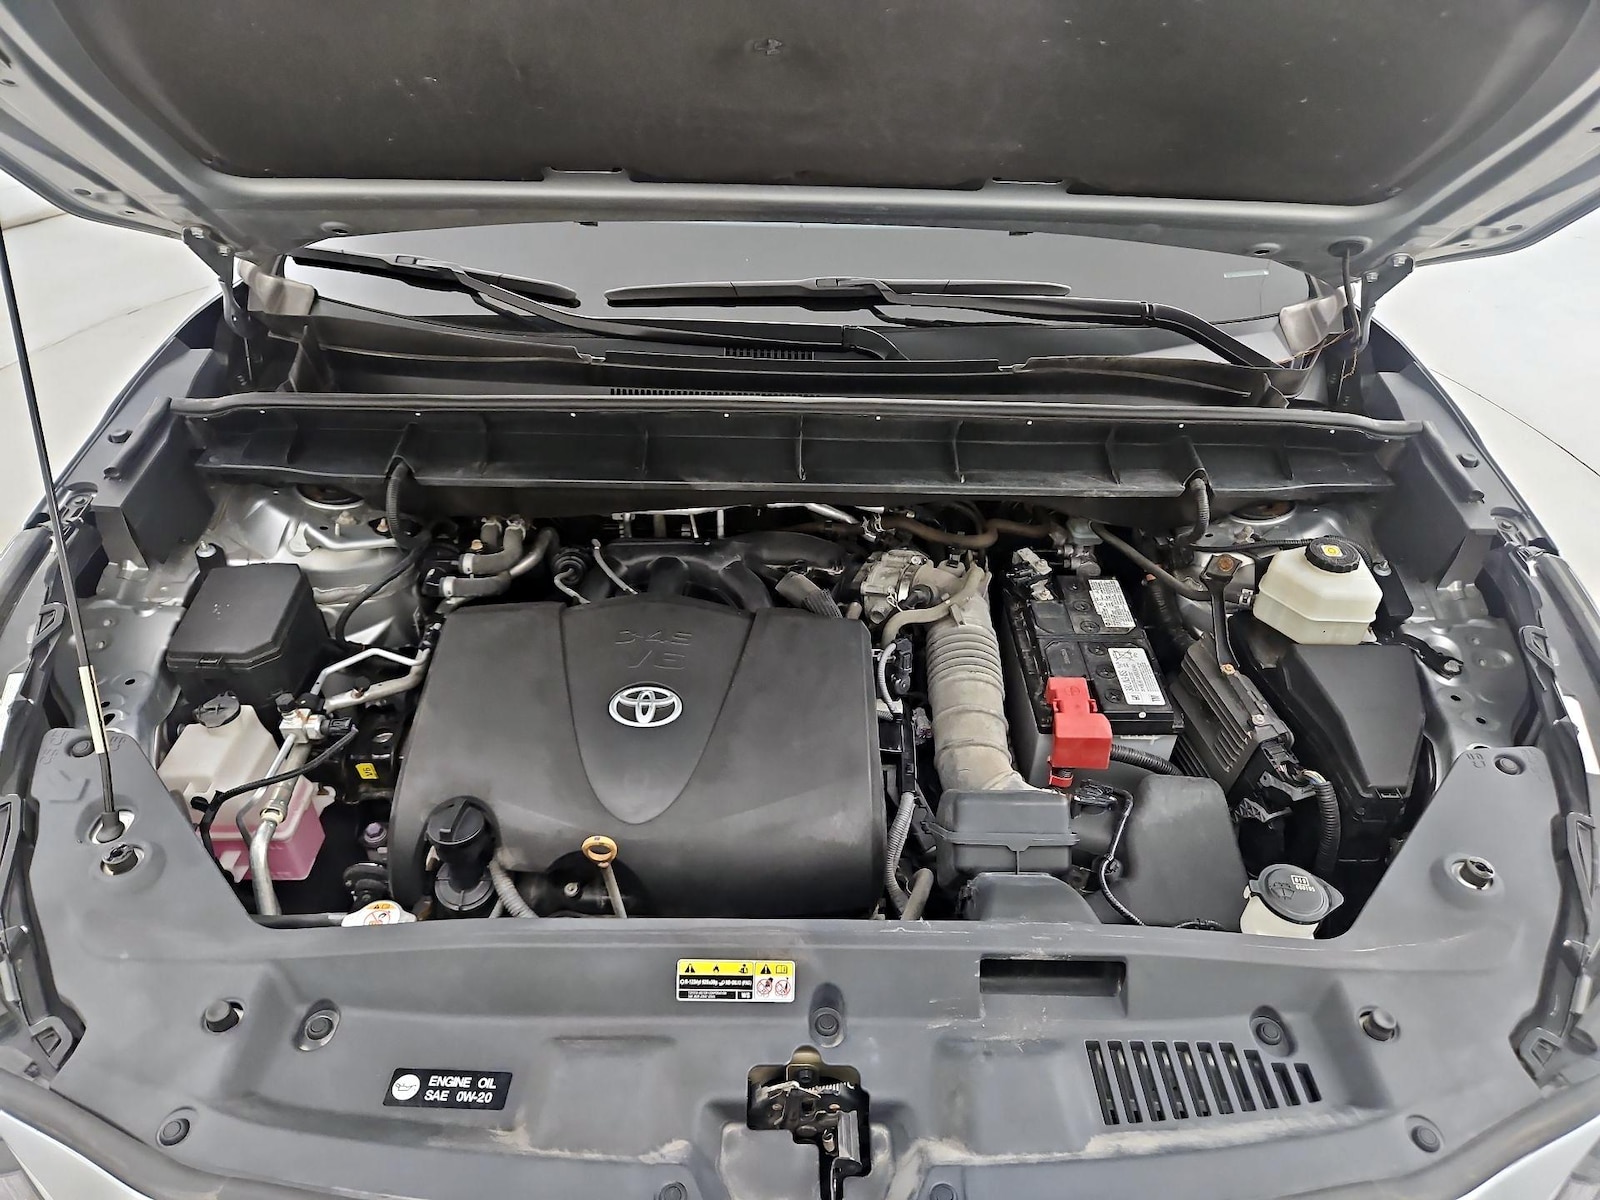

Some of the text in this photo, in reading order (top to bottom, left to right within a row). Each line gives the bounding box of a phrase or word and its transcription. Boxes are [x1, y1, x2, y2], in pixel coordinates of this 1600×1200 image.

[428, 1075, 497, 1089] ENGINE OIL
[424, 1090, 493, 1103] SAE 0W-20
